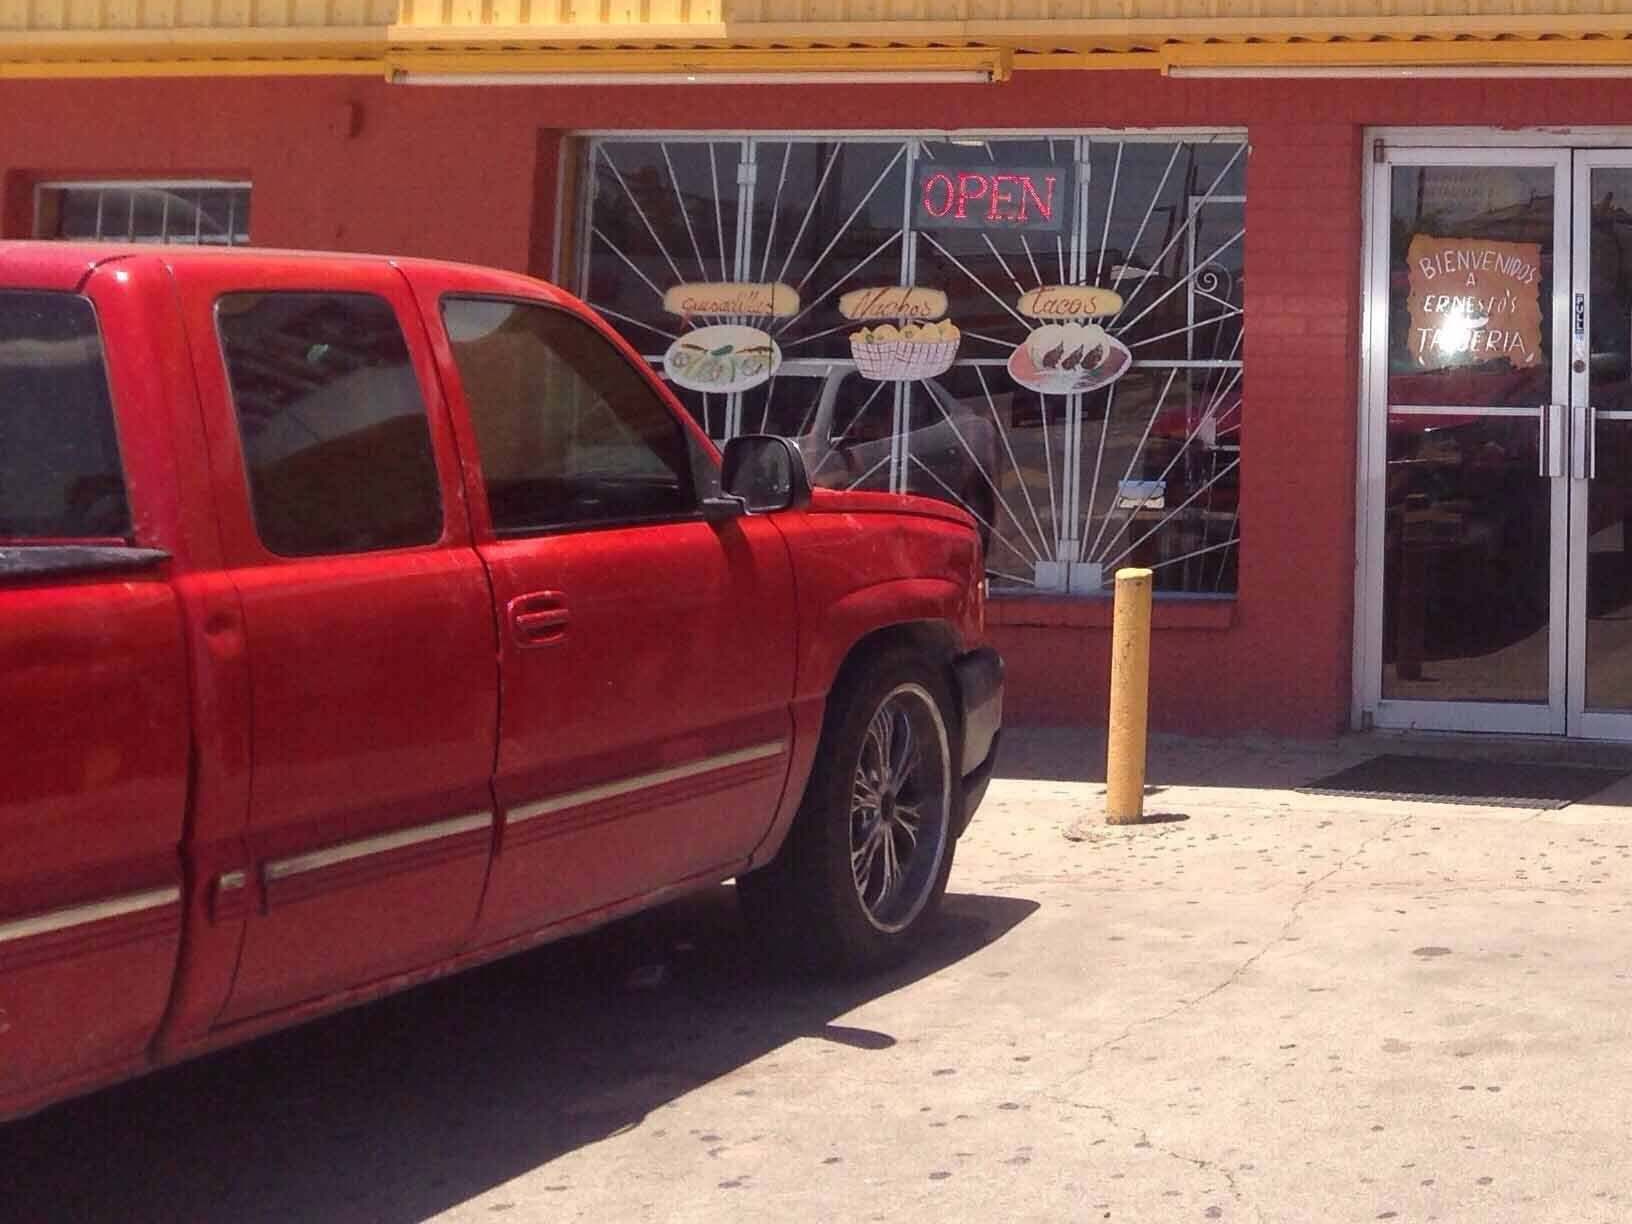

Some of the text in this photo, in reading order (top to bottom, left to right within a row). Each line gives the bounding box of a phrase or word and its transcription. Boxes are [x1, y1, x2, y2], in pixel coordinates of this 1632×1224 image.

[922, 172, 1057, 222] OPEN
[1418, 250, 1537, 284] BIENVENIDOS
[1465, 273, 1476, 286] A
[1417, 327, 1526, 355] TAUERIA
